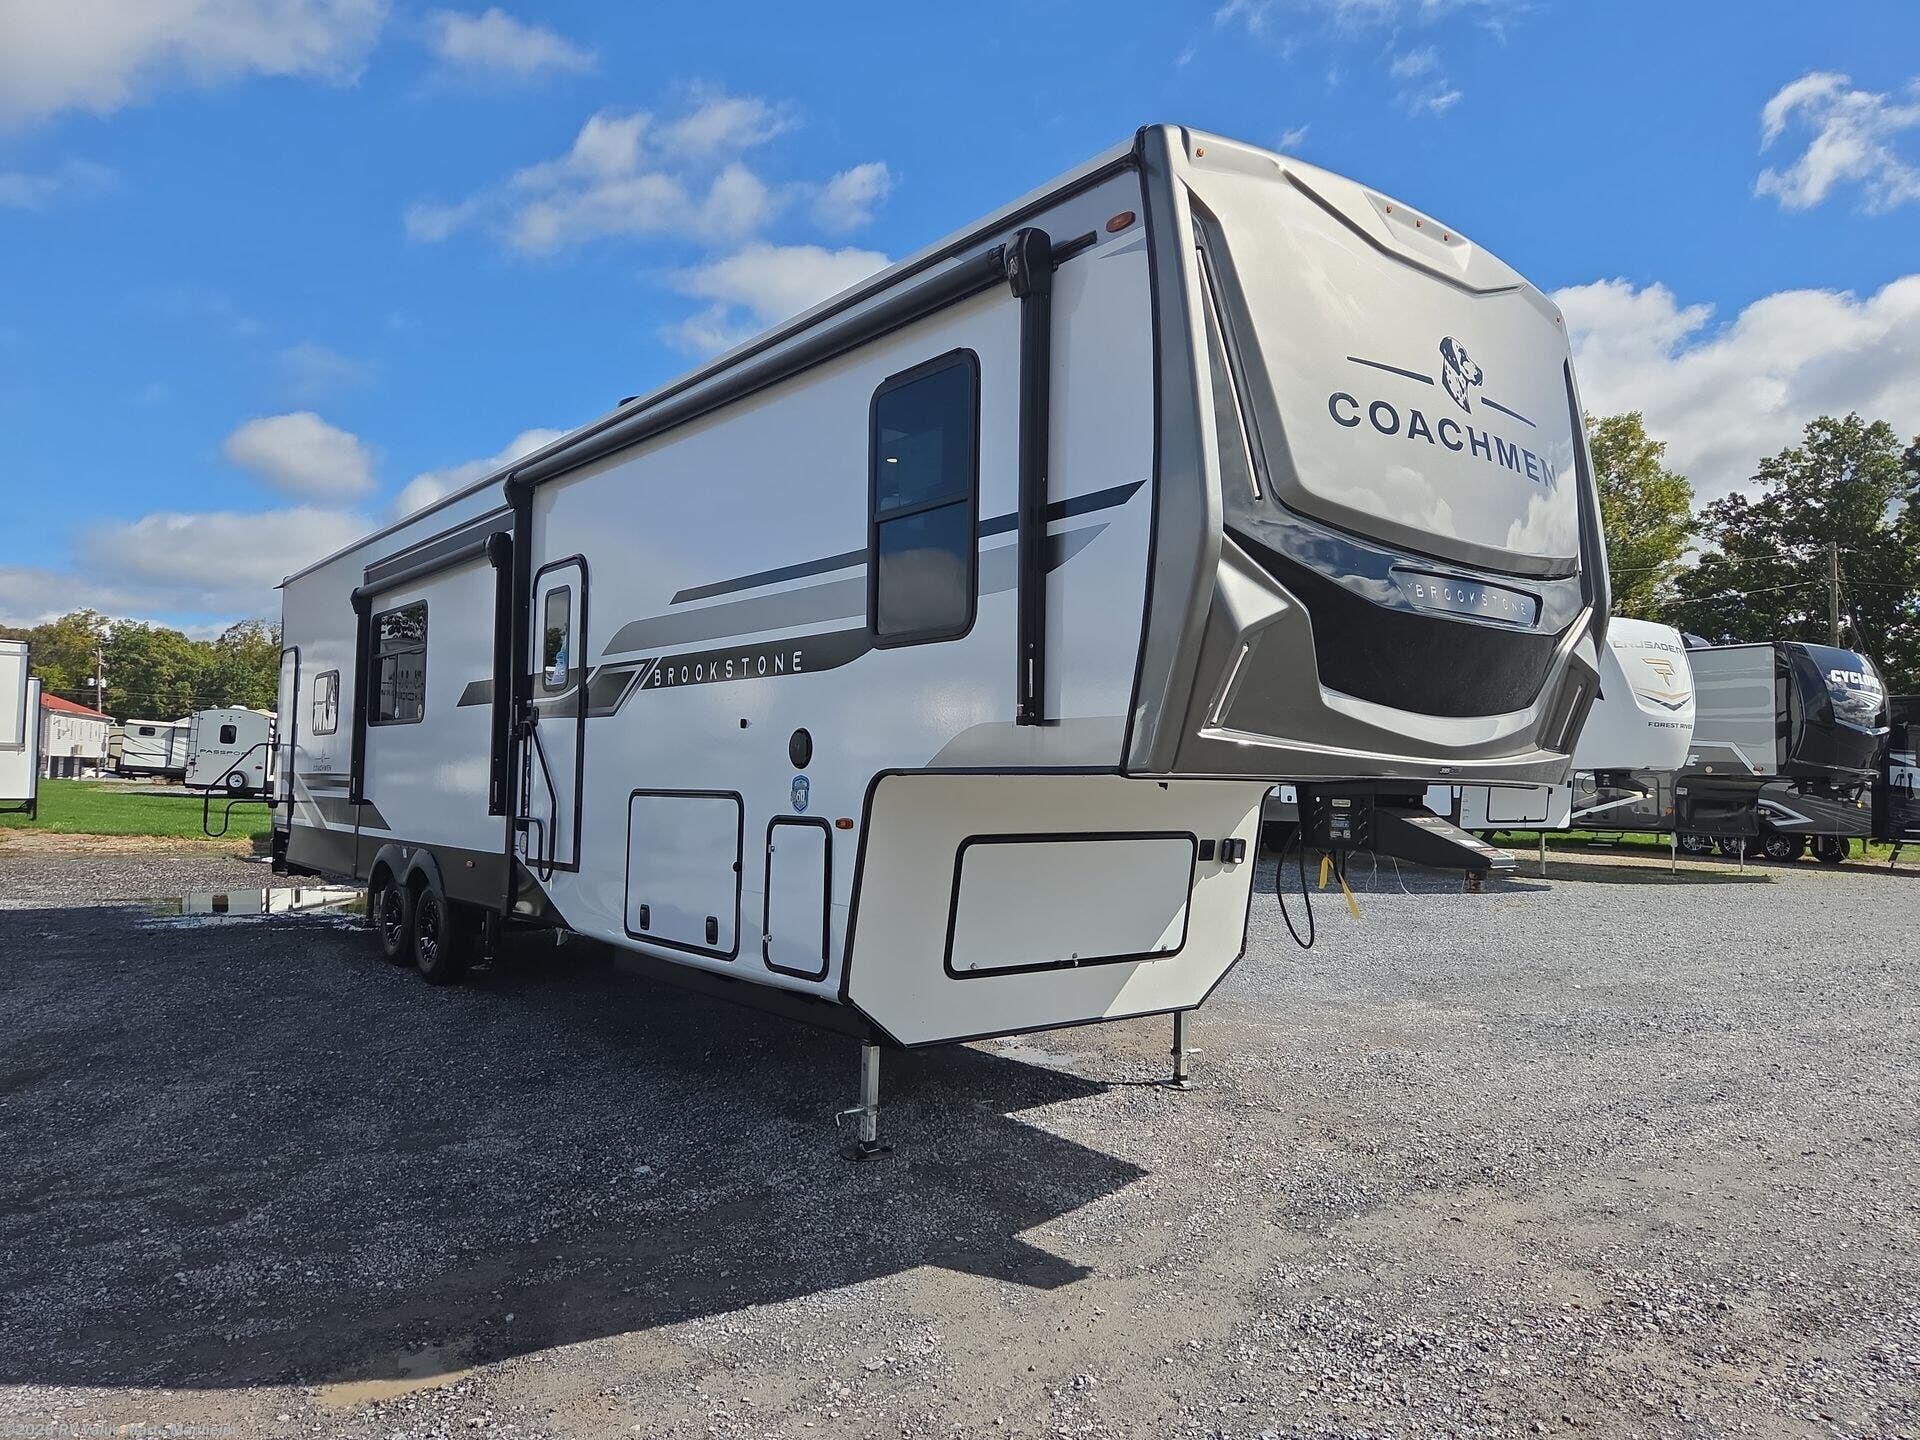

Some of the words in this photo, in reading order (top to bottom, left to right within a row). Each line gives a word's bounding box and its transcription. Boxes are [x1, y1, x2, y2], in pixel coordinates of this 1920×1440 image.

[1328, 391, 1558, 493] COACHMEN
[1415, 584, 1527, 615] BROOKSTONE
[1613, 641, 1683, 655] CRUSADER
[654, 651, 802, 686] BROOKSTONE
[1648, 721, 1679, 729] FOREST
